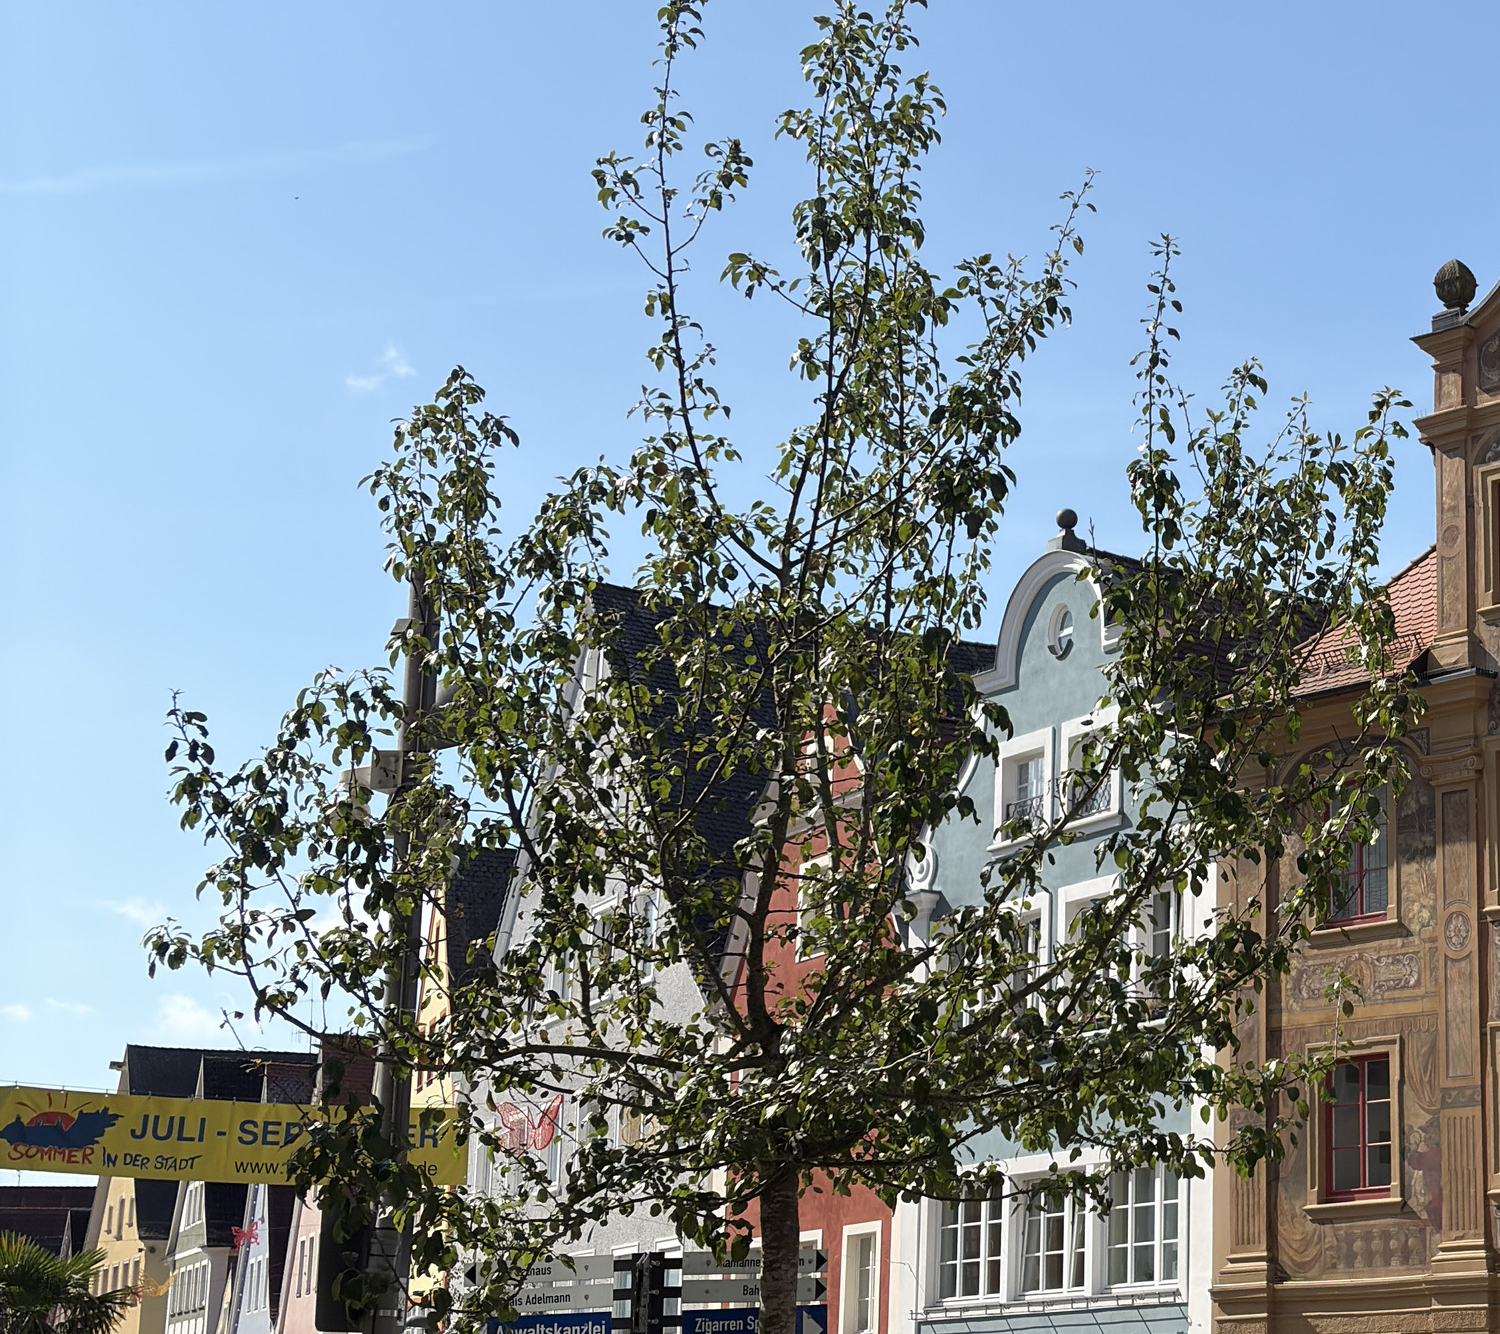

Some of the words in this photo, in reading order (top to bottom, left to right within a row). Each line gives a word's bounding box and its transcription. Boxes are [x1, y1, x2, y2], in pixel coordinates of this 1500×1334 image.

[130, 1114, 206, 1143] JULI
[8, 1143, 95, 1165] SOMMER
[123, 1153, 150, 1168] DER
[154, 1154, 203, 1172] STADT
[525, 1293, 571, 1307] Adelmann
